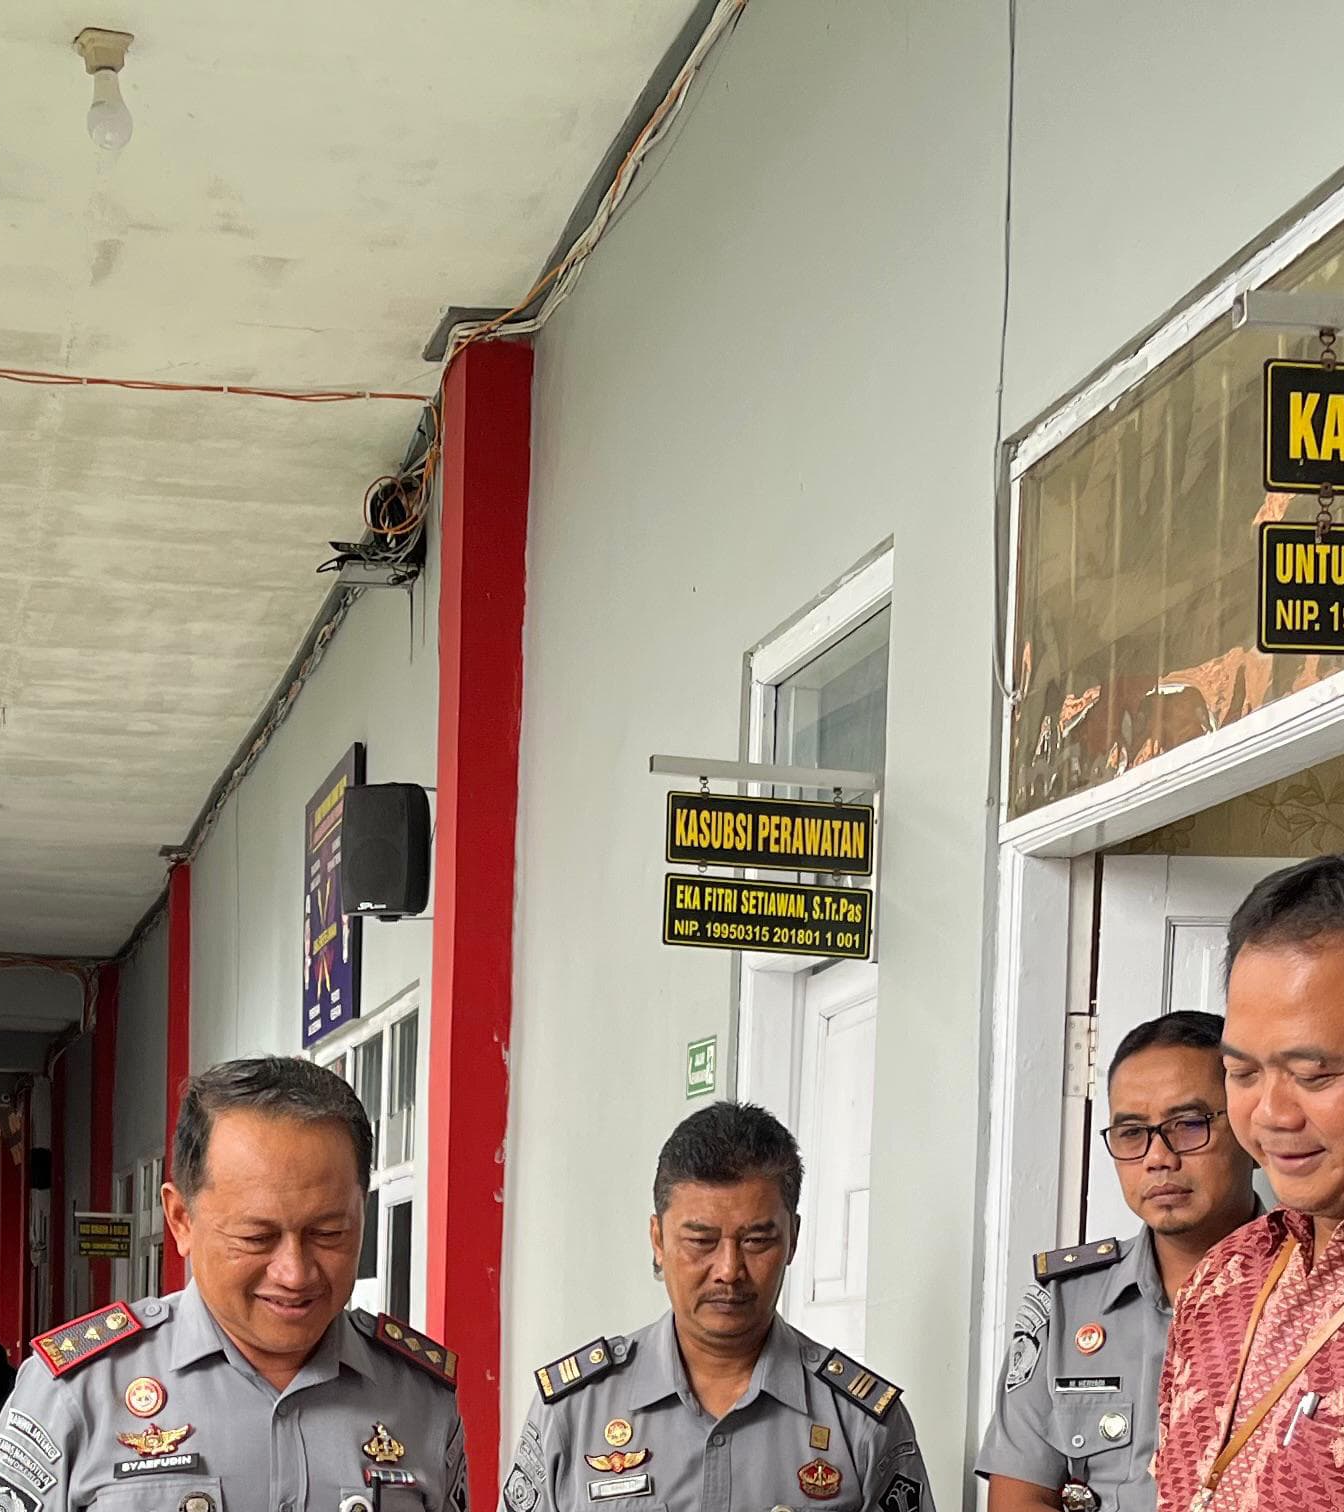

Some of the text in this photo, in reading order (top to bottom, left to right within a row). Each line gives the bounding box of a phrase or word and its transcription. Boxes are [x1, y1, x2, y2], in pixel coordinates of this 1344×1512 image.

[1275, 600, 1320, 631] NIP.
[675, 808, 865, 858] KASUBSI PERAWATAN
[676, 885, 862, 923] EKA FITRI SETIAWAN, S.Tr.Pas
[674, 919, 859, 948] NIP. 19950315 201801 1 001
[121, 1455, 192, 1472] SYAEFUDIN
